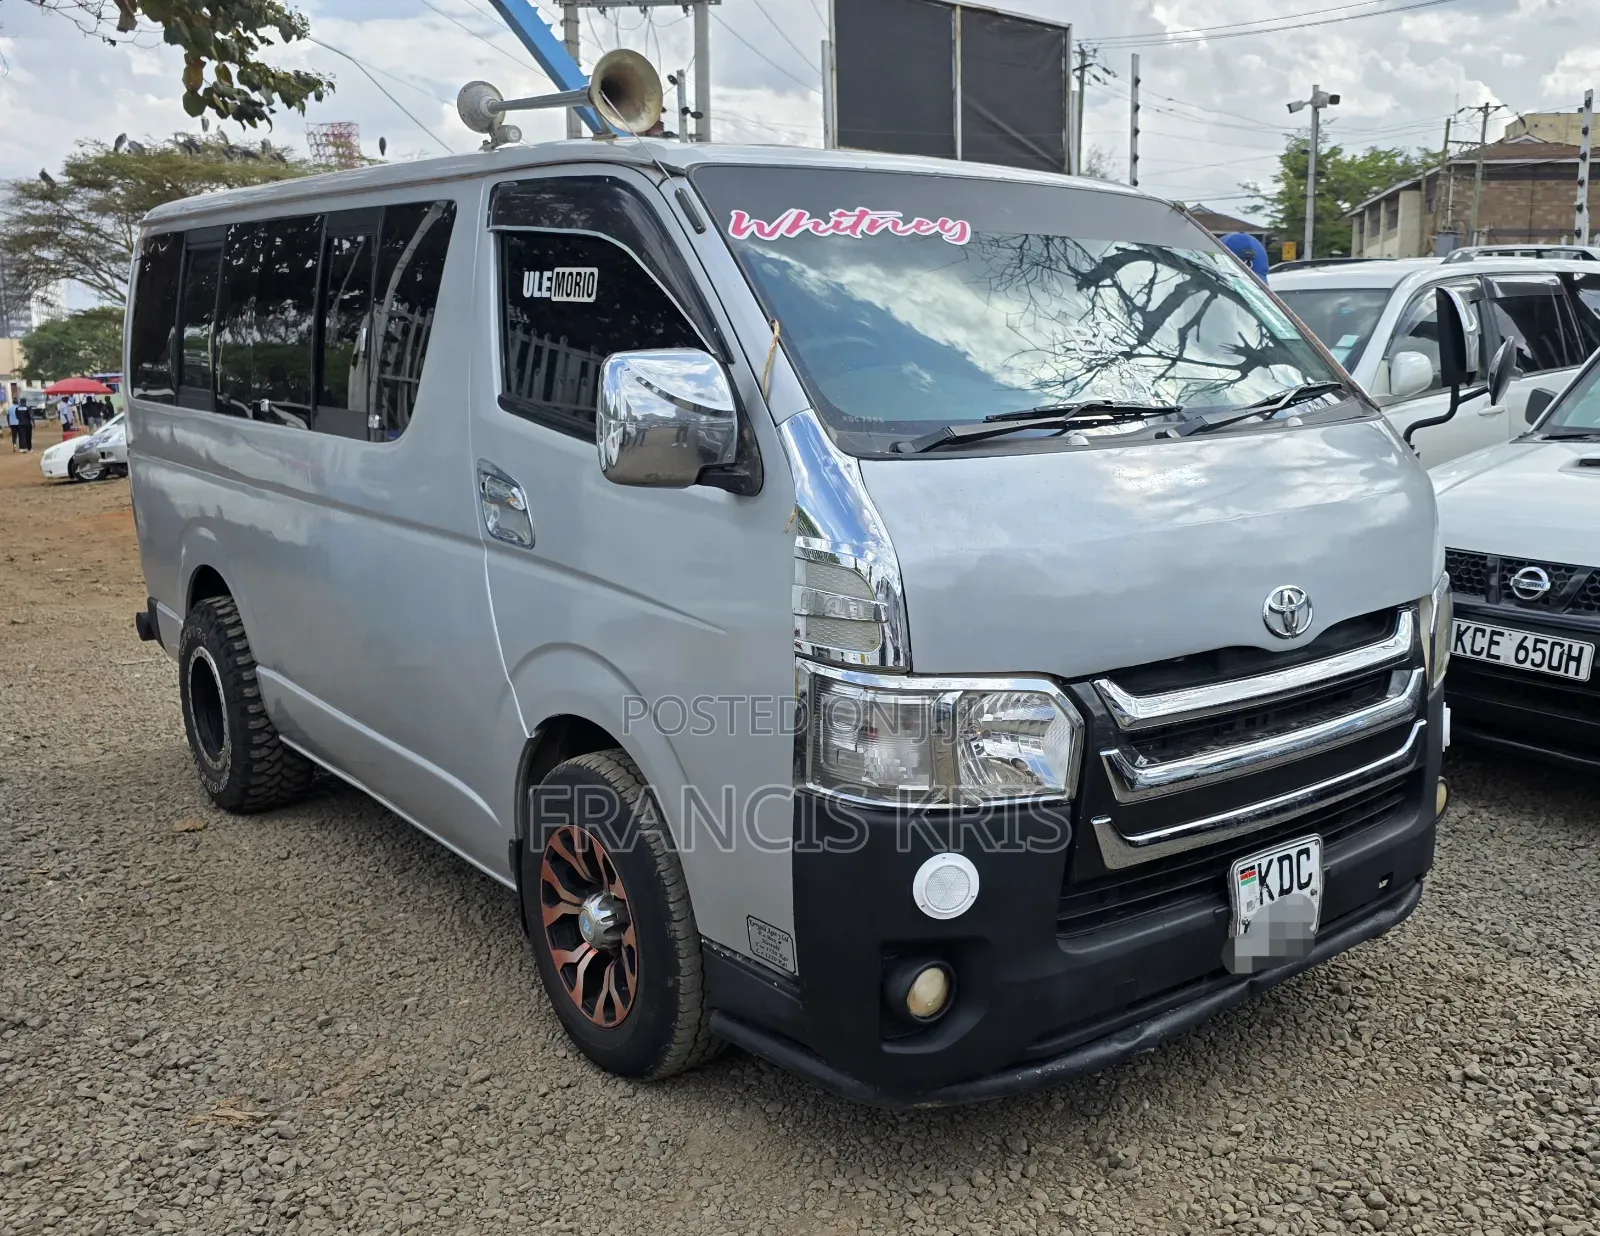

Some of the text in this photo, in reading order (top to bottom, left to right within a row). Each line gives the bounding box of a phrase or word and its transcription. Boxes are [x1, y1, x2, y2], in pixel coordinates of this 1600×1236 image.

[728, 206, 971, 245] Whitney
[1453, 623, 1585, 677] KCE 650H
[1257, 846, 1313, 905] KDC
